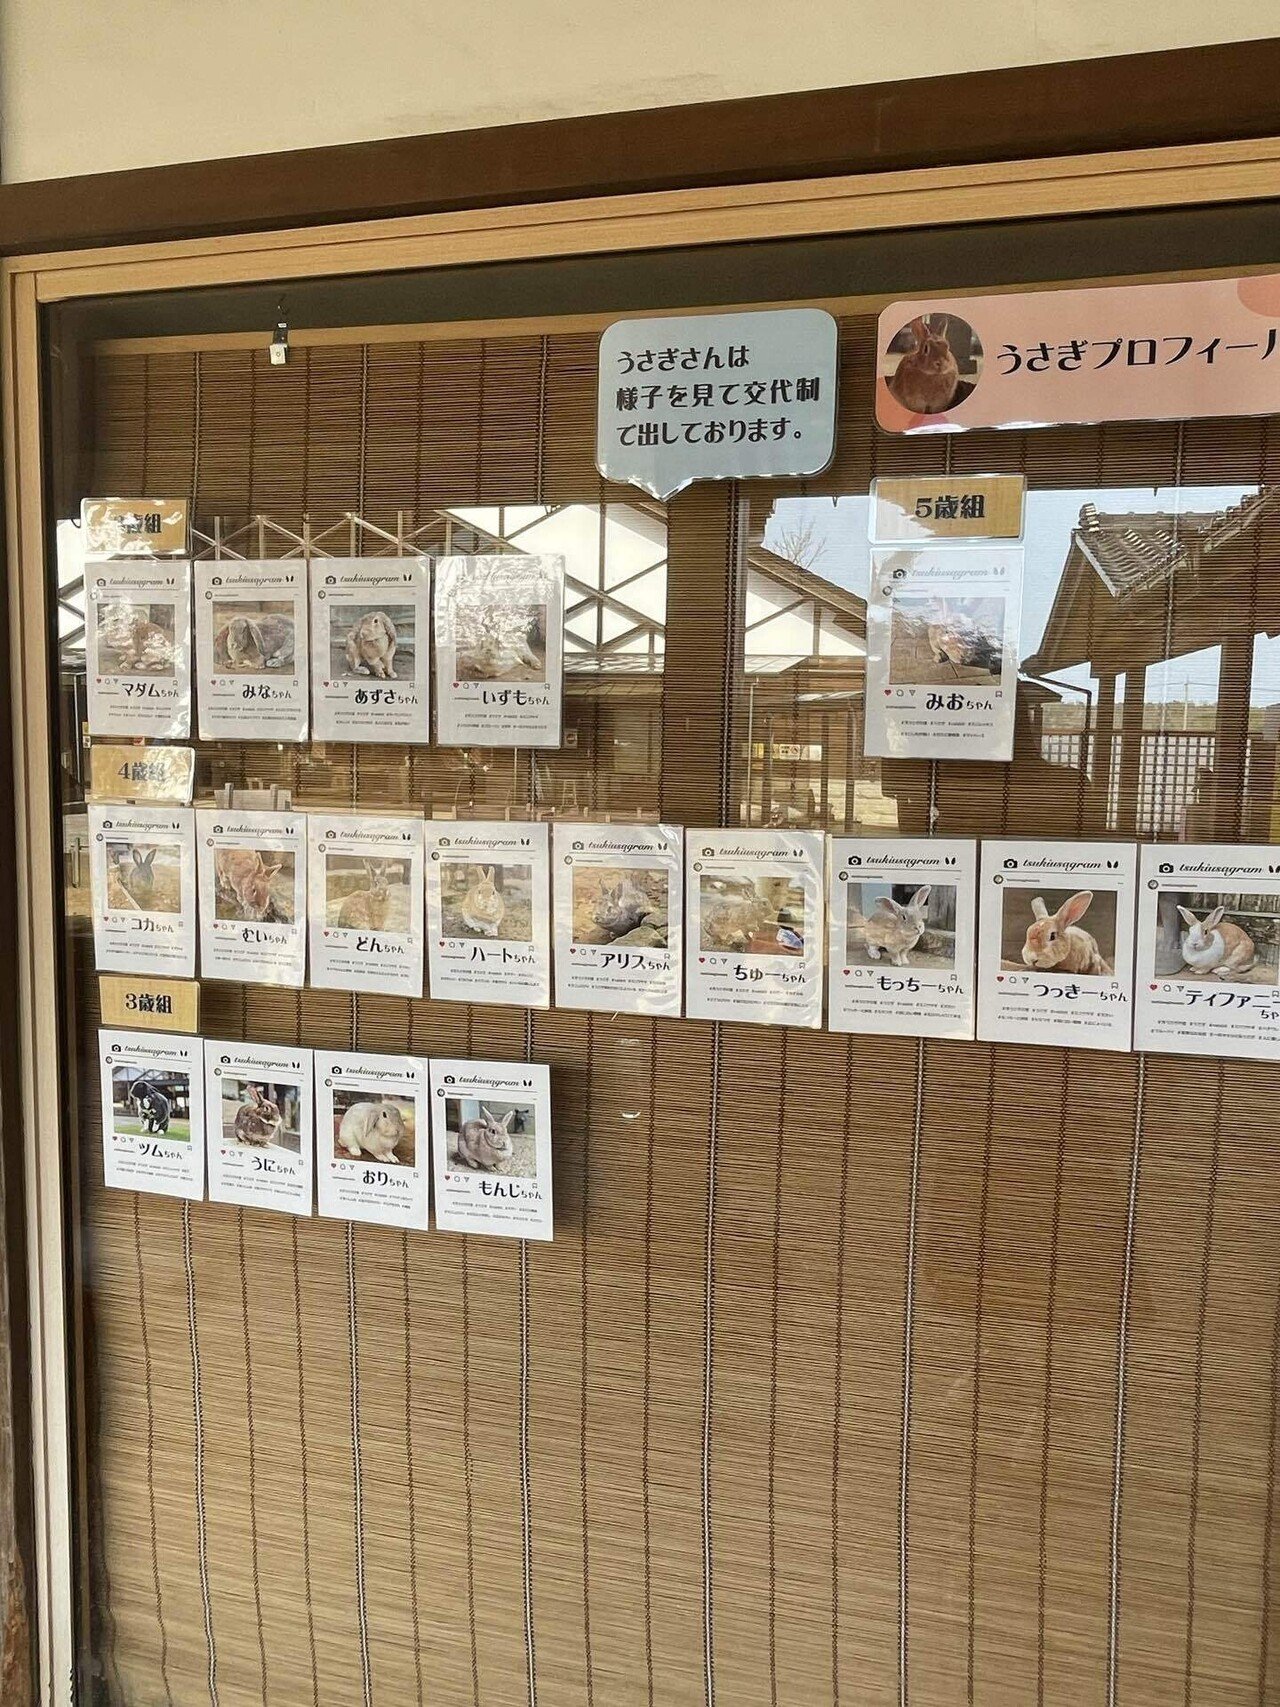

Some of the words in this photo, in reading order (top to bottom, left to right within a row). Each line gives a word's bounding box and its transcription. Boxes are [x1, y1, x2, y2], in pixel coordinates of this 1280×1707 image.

[616, 345, 749, 374] うさぎさんは
[615, 377, 820, 411] 様子を見て交代制
[616, 418, 804, 447] て出しております。
[915, 494, 985, 520] 5歳組
[225, 575, 284, 586] tsukiusagram
[339, 574, 400, 586] tsukiusagram
[122, 682, 179, 699] マダムちゃん
[241, 683, 292, 700] みなちゃん
[354, 688, 419, 705] あずさちゃん
[483, 689, 551, 706] いずもちゃん
[926, 692, 993, 711] みおちゃん
[227, 825, 283, 836] tsukiusagram
[340, 829, 400, 841] tsukiusagram
[454, 837, 517, 848] tsukiusagram
[588, 840, 654, 852] tsukiusagram
[719, 846, 789, 859] tsukiusagram
[866, 854, 941, 867] tsukiusagram
[1023, 858, 1102, 872] tsukiusagram
[1179, 863, 1263, 876] tsukiusagram
[131, 917, 174, 933] コカちゃん
[241, 927, 288, 945] むいちゃん
[355, 936, 405, 954] どんちゃん
[470, 946, 536, 964] ハートちゃん
[600, 952, 670, 971] アリスちゃん
[733, 963, 806, 984] ちゅーちゃん
[877, 975, 964, 995] もっちーちゃん
[1033, 983, 1128, 1003] つっきーちゃん
[125, 993, 172, 1015] 3歳組
[124, 1044, 177, 1057] tsukiusagram
[234, 1056, 289, 1069] tsukiusagram
[345, 1066, 403, 1079] tsukiusagram
[458, 1075, 518, 1088] tsukiusagram
[138, 1142, 182, 1160] ツムちゃん
[251, 1156, 296, 1175] うにちゃん
[362, 1169, 409, 1189] おりちゃん
[478, 1179, 543, 1201] もんじちゃん
